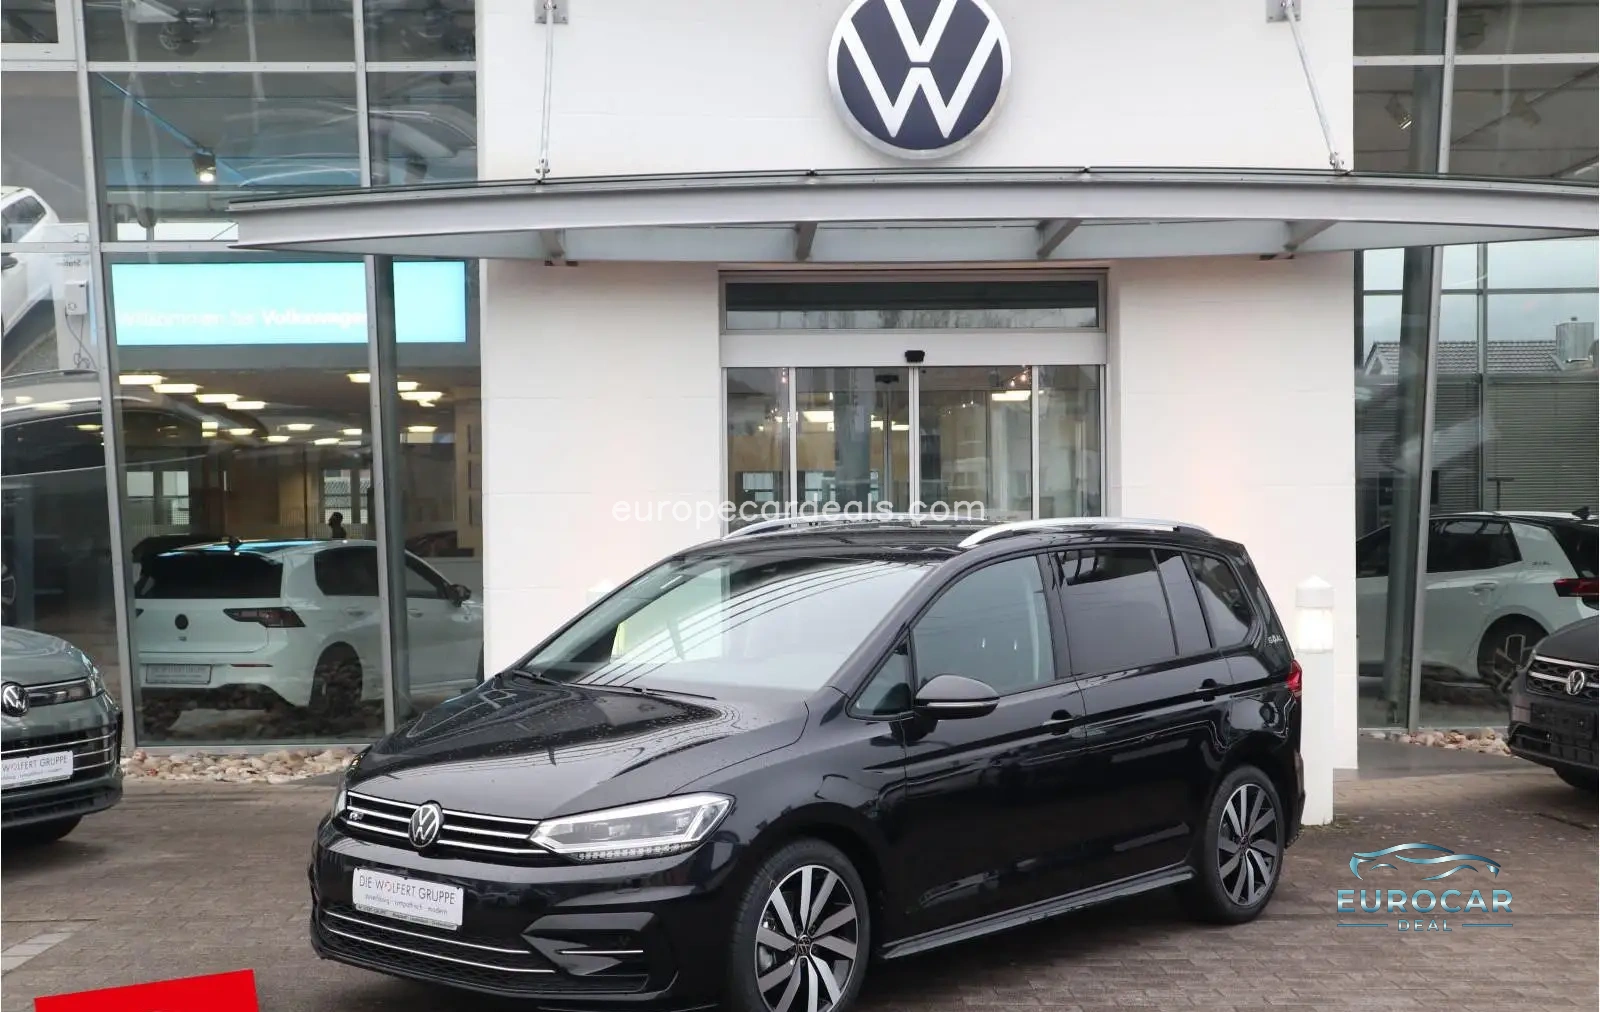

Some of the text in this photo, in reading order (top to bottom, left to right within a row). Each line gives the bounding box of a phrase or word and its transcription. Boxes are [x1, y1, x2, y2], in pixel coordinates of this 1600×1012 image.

[39, 755, 68, 768] GRUPPE
[359, 875, 456, 905] DIE WOLFERT GRUPPE
